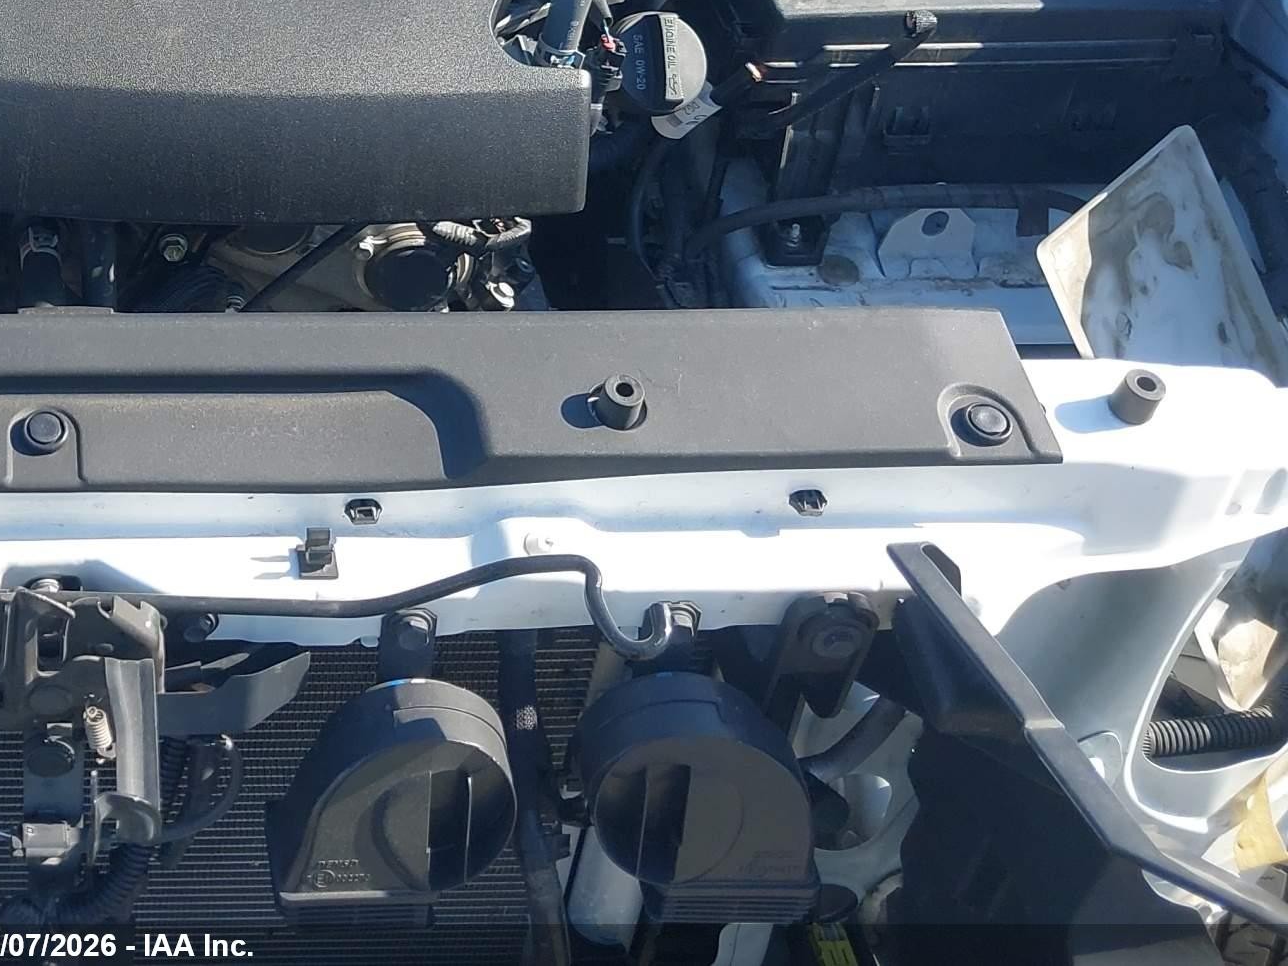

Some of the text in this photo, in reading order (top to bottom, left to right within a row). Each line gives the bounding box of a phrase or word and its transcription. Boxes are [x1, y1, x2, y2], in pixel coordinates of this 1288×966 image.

[632, 34, 648, 91] SAE 0W-20
[663, 16, 677, 69] ENGINE OIL
